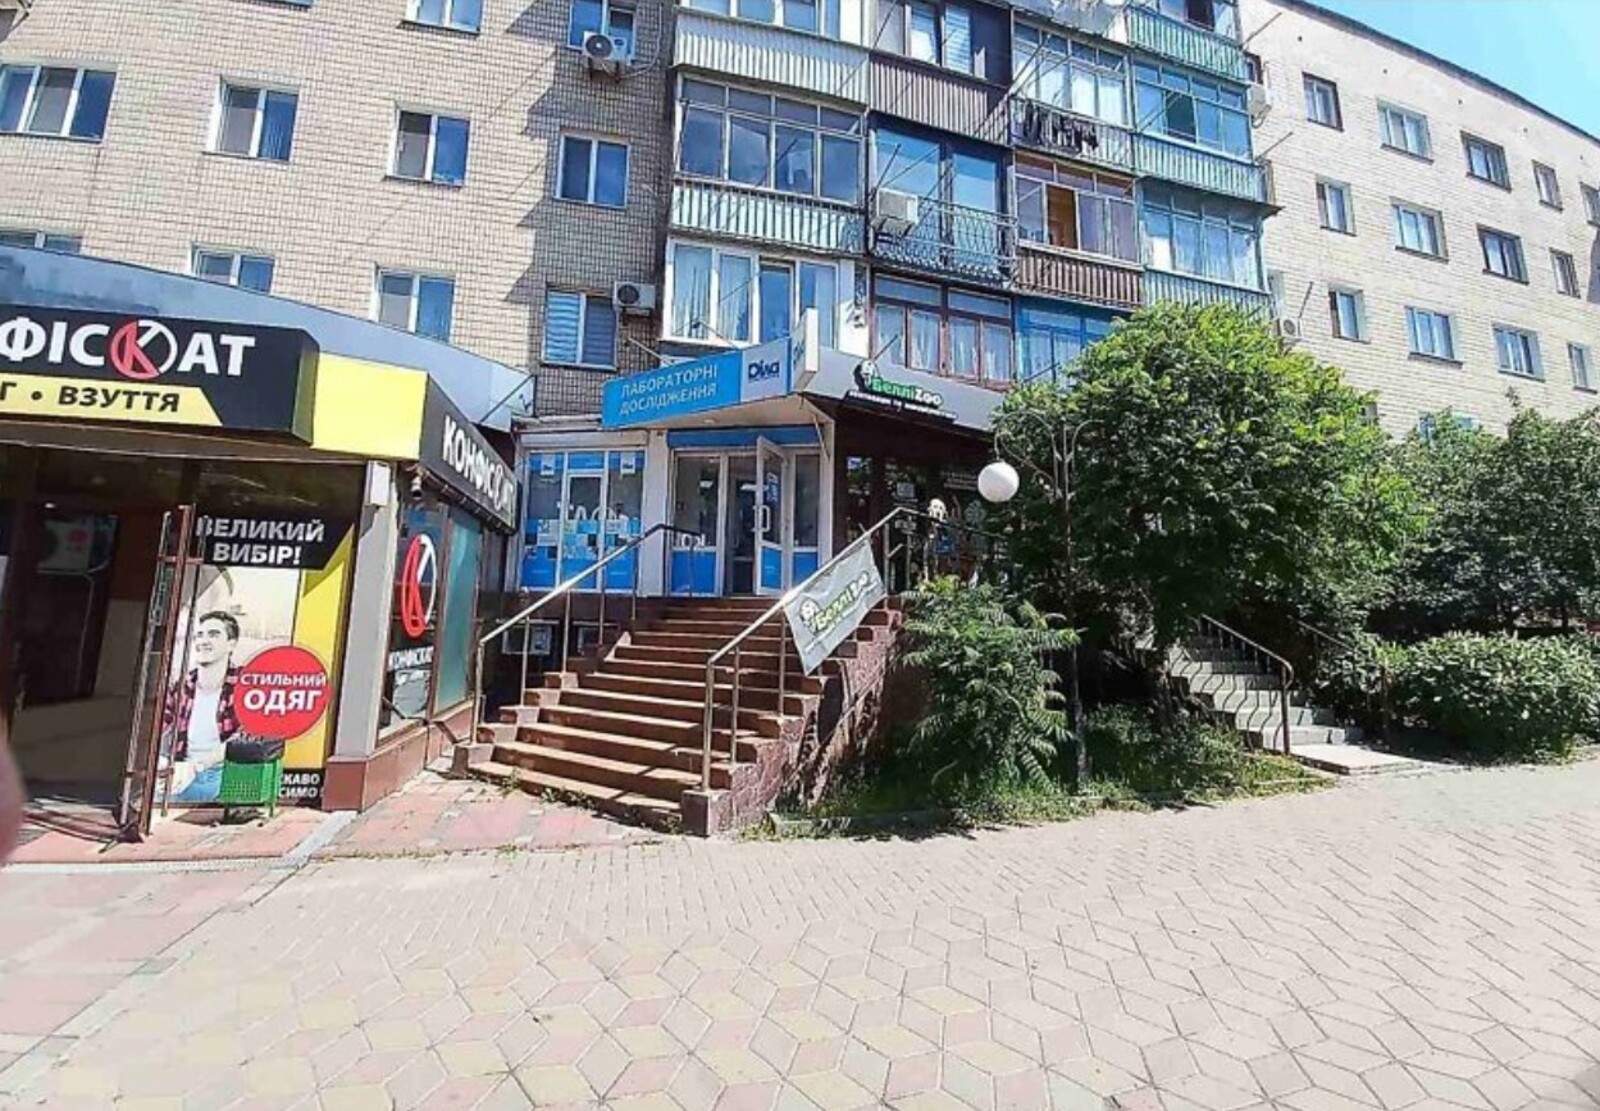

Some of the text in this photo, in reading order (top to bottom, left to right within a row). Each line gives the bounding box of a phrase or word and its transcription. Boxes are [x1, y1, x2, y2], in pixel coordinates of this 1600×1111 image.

[621, 365, 718, 398] ЛАБОРАТОРНІ
[58, 385, 180, 412] ВЗУТТЯ
[619, 382, 717, 417] ДОСЛІДЖЕННЯ
[196, 517, 325, 541] ВЕЛИКИЙ
[213, 543, 301, 565] ВИБІР!
[241, 673, 326, 686] СТИЛЬНИЙ
[244, 689, 322, 716] ОДЯГ
